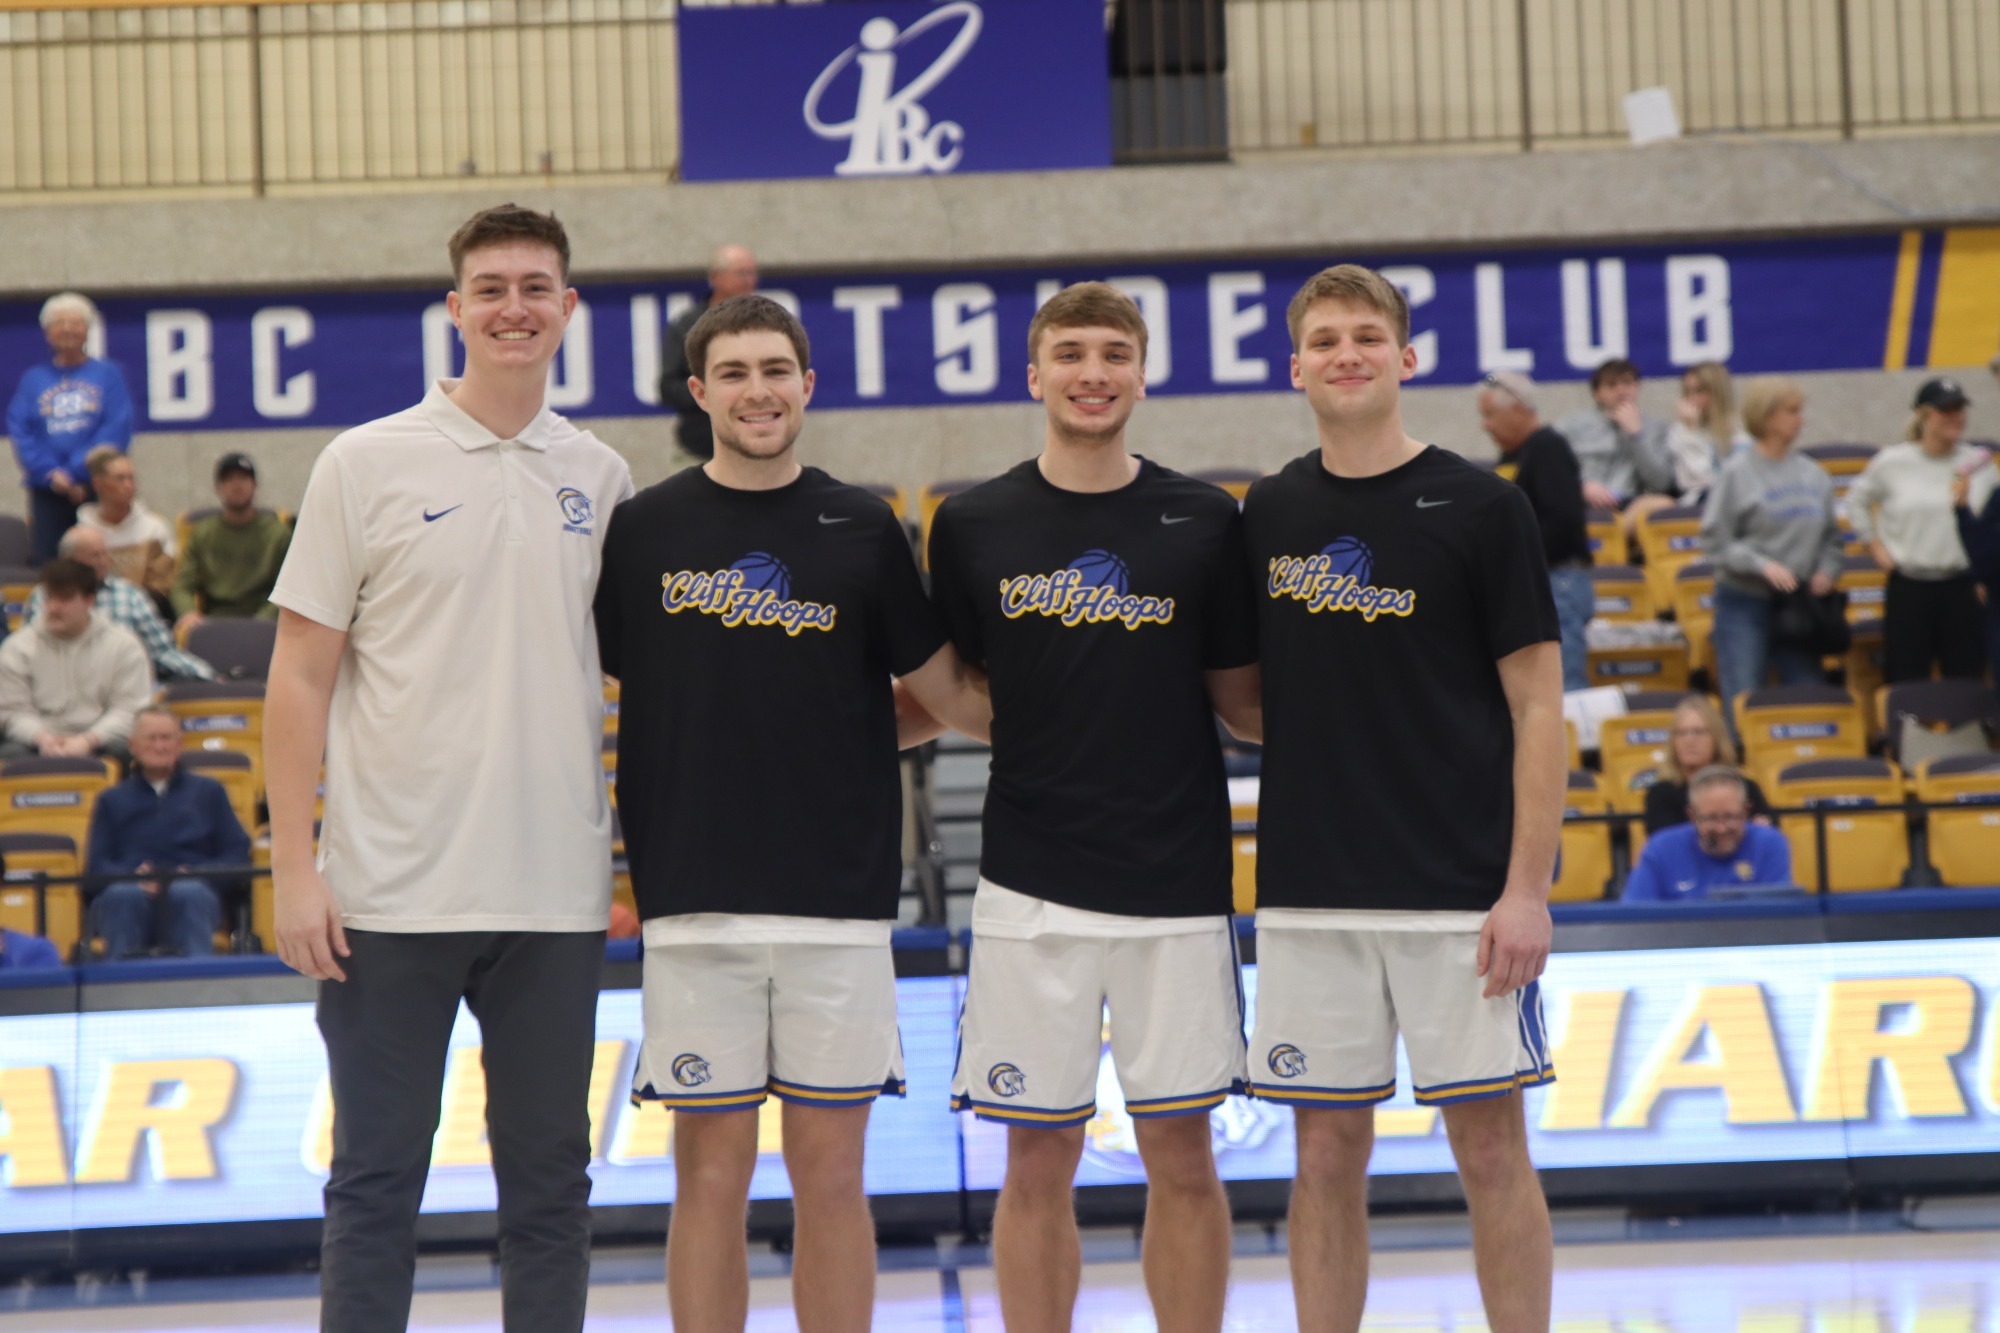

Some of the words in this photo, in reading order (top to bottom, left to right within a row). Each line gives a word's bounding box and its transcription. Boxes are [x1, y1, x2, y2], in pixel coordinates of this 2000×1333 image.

[721, 588, 837, 636] Hoops
[1061, 585, 1175, 631] Hoops
[1307, 574, 1416, 623] Hoops
